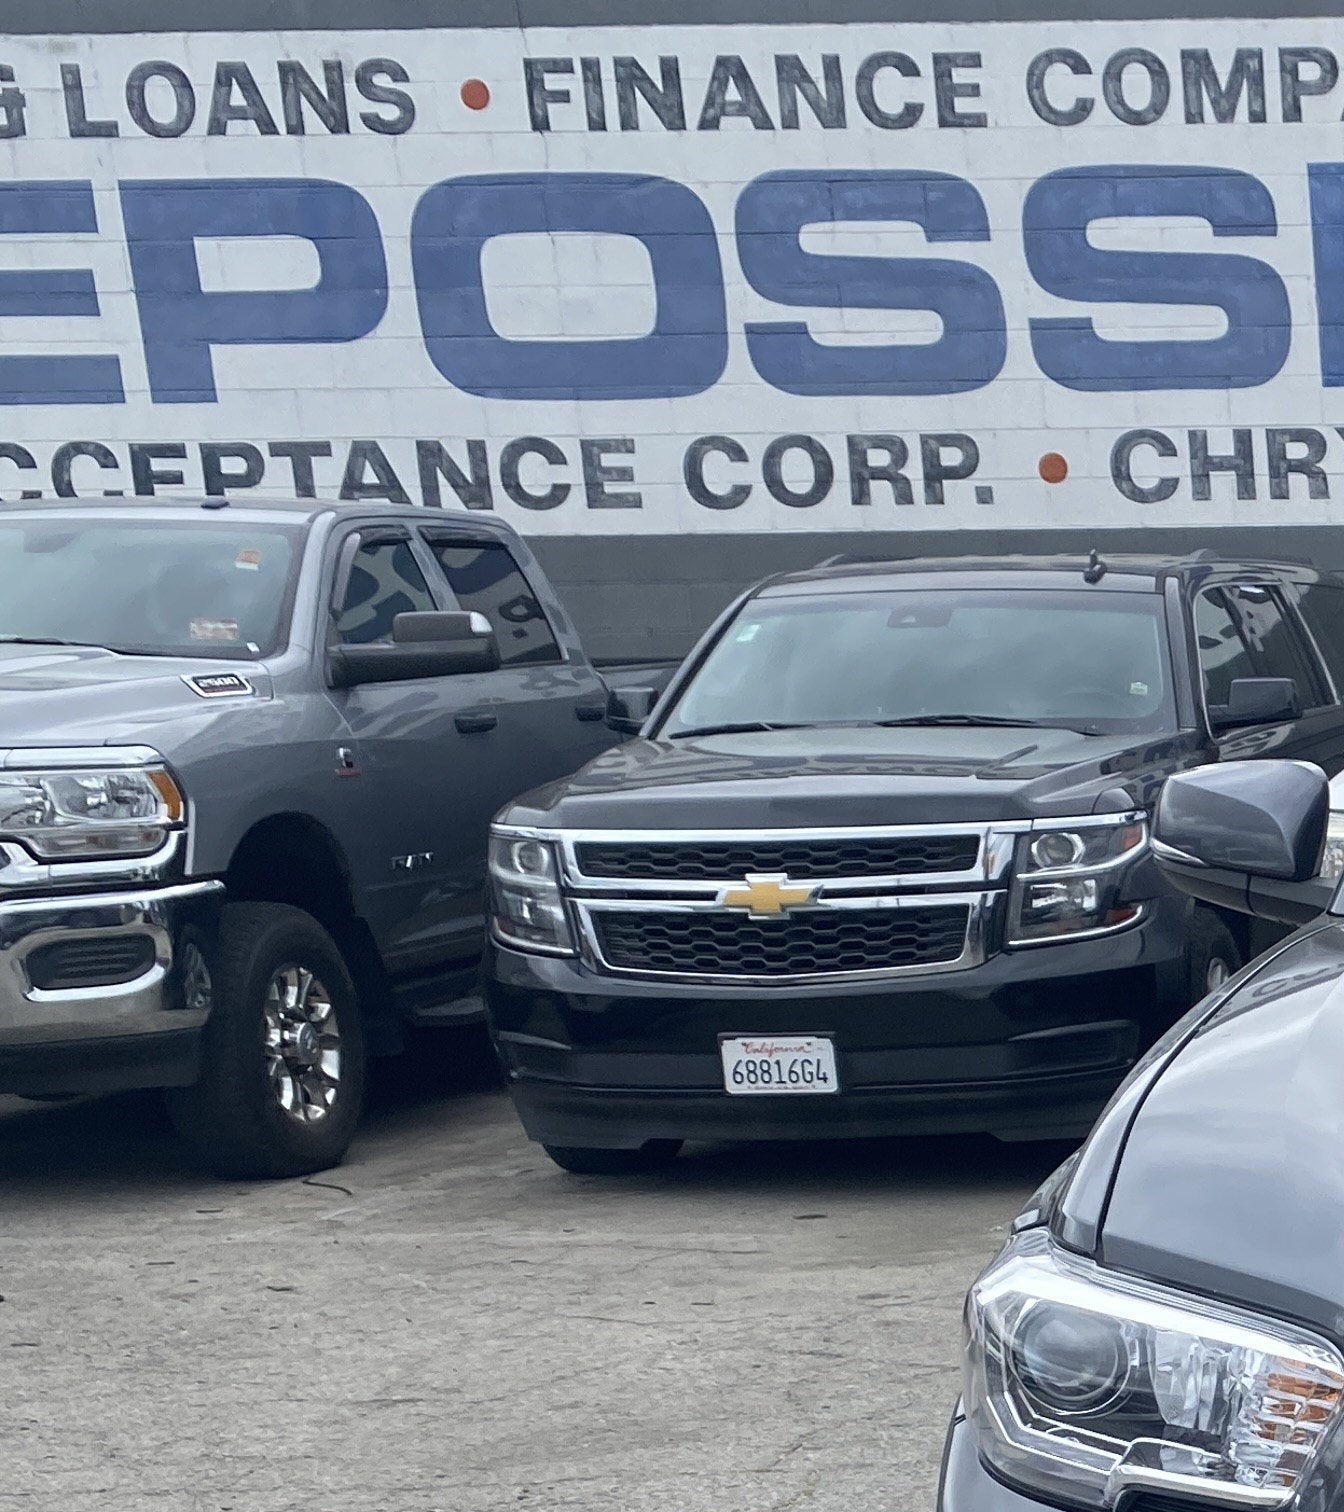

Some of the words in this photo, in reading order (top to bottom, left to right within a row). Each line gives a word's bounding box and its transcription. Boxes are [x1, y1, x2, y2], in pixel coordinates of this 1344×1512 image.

[60, 58, 416, 138] LOANS
[524, 51, 989, 132] FINANCE
[684, 434, 993, 510] CORP.
[732, 1059, 829, 1084] 68816G4
